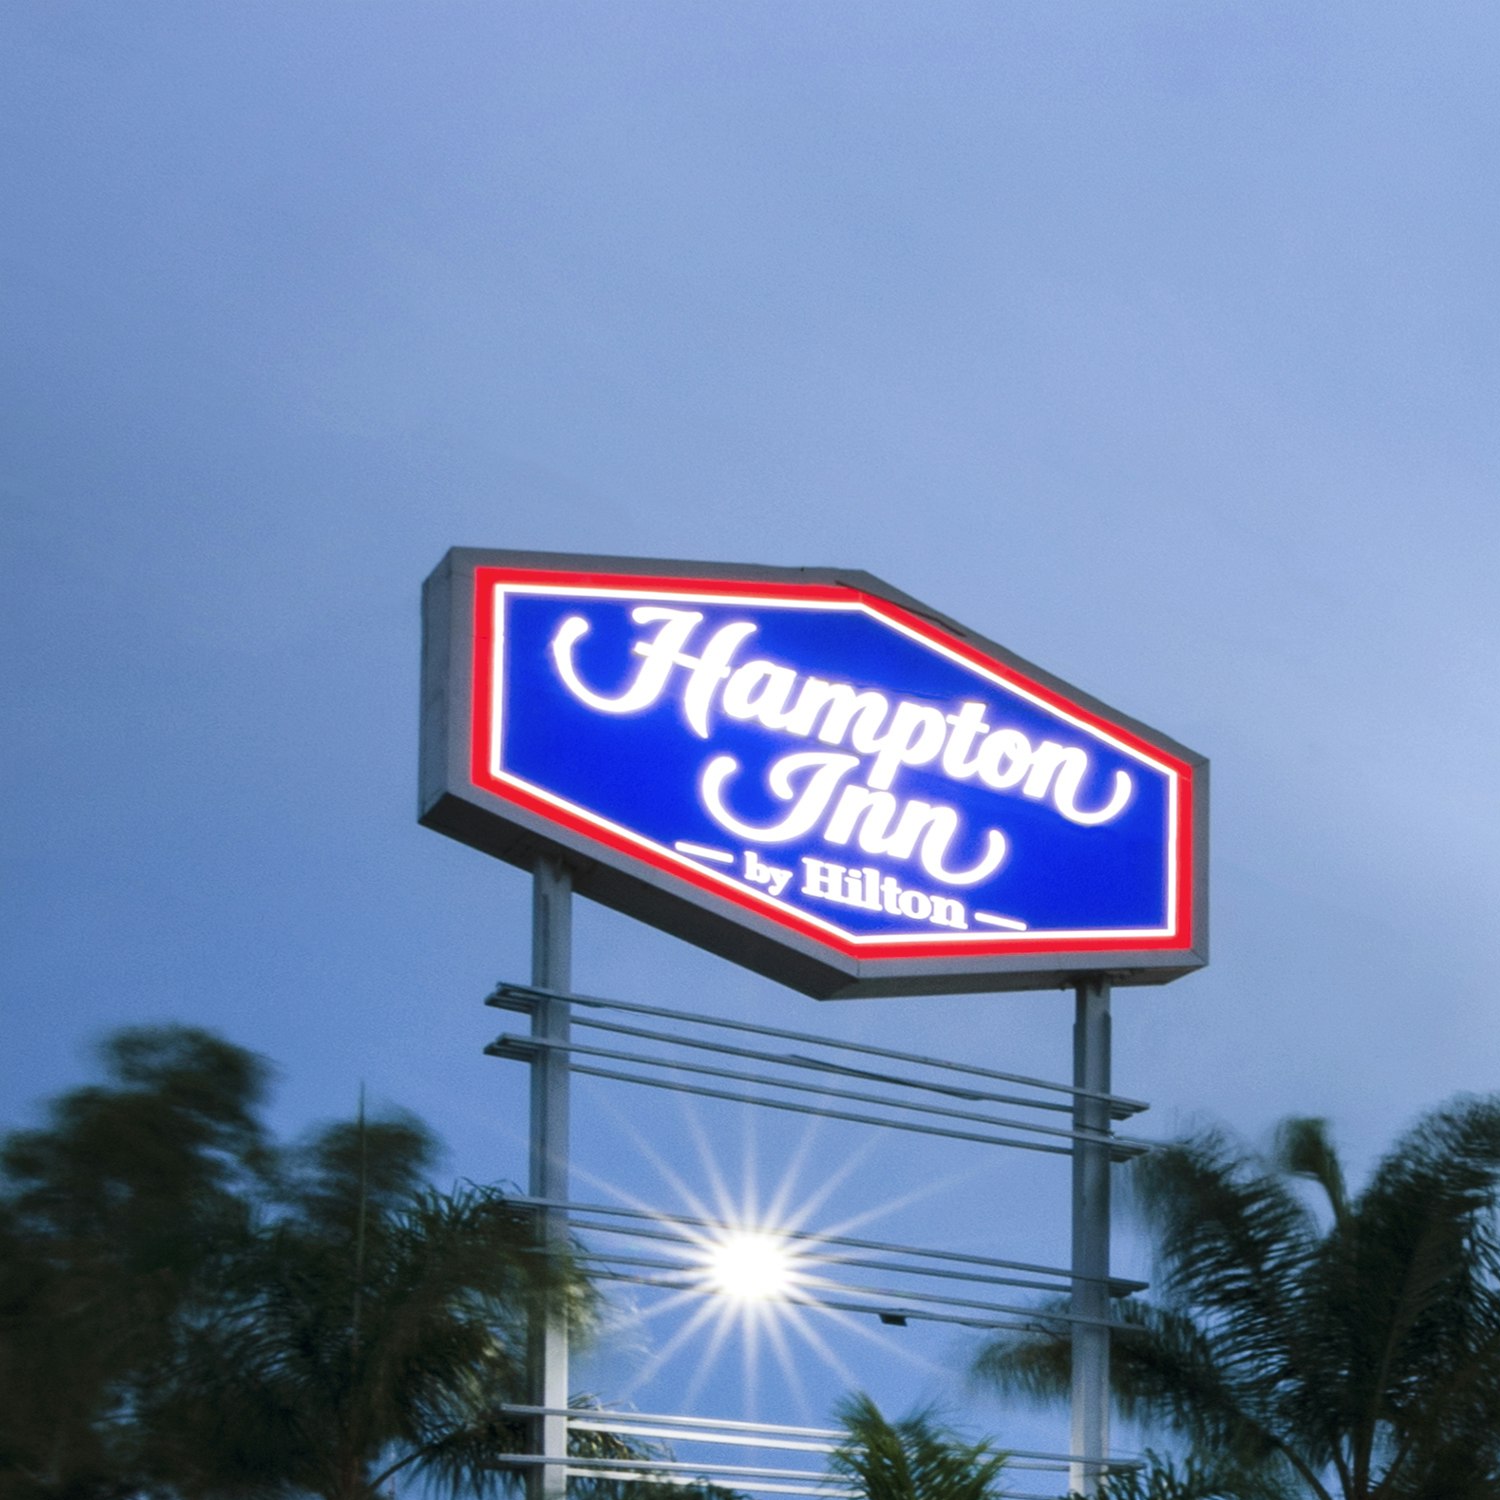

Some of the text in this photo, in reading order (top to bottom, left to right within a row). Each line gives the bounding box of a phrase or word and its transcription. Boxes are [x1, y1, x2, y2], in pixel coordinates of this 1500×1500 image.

[552, 606, 1132, 826] Hampton
[702, 752, 1007, 884] Inn
[743, 851, 968, 930] by Hilton
